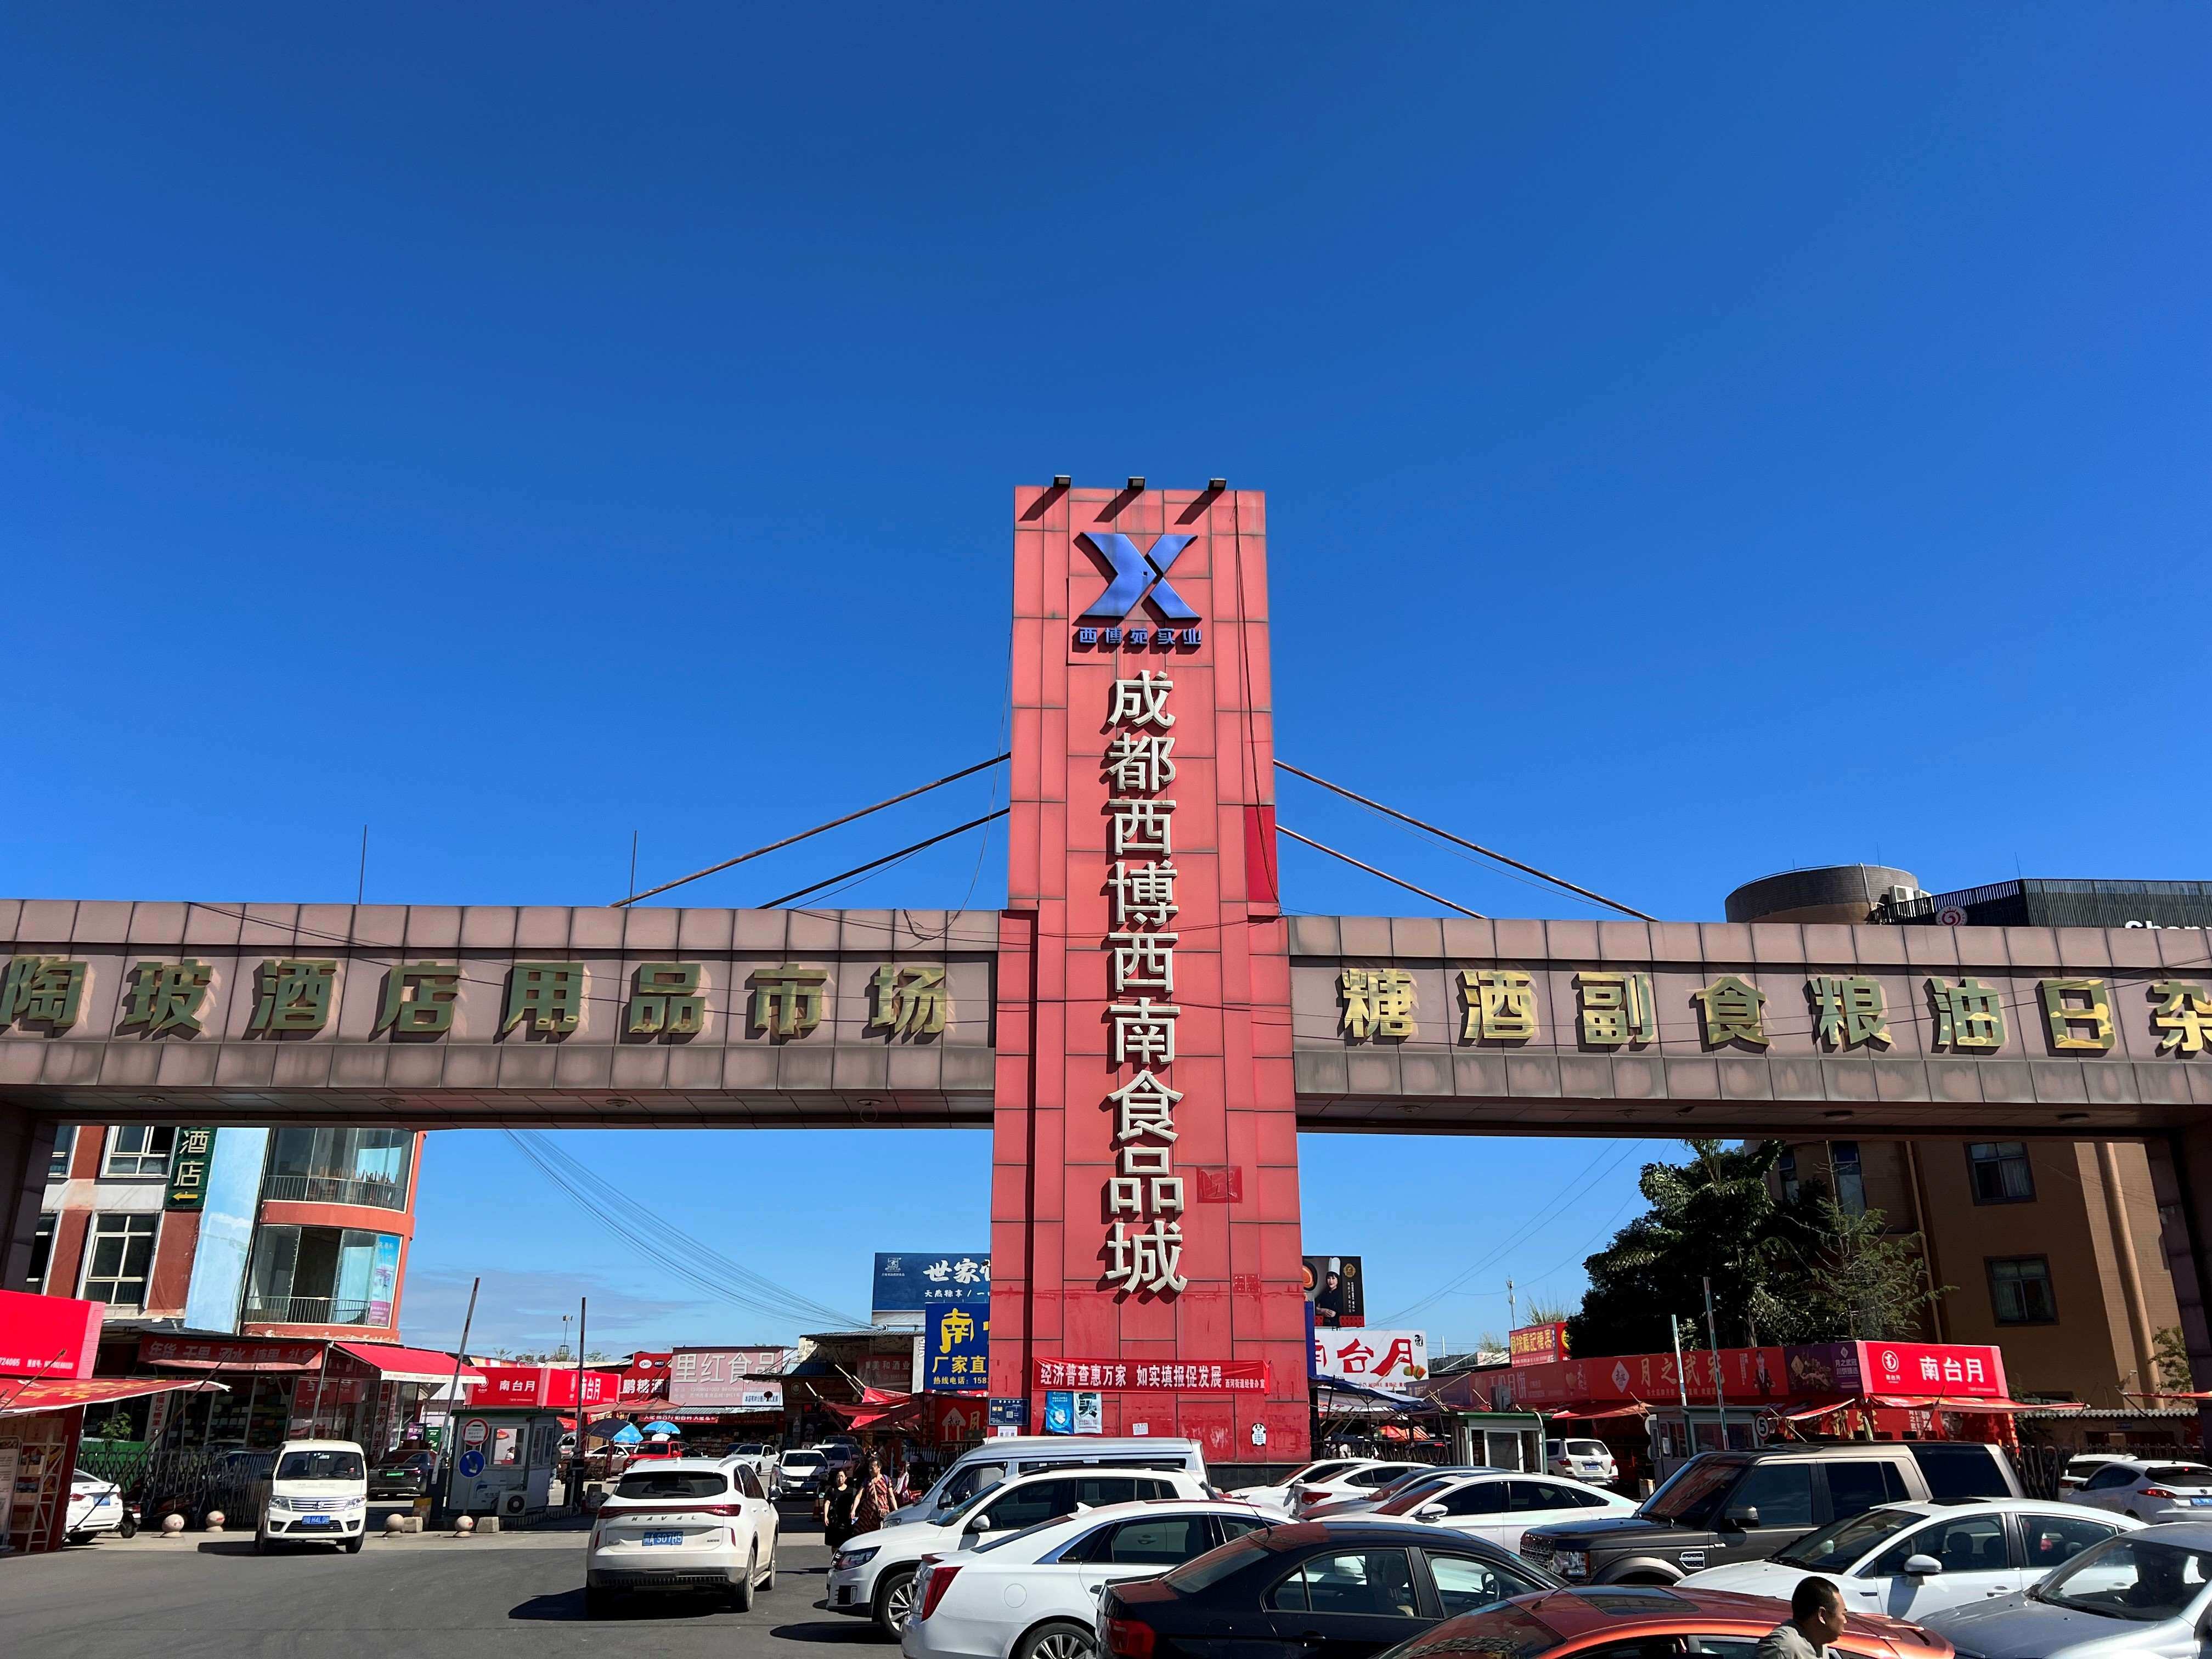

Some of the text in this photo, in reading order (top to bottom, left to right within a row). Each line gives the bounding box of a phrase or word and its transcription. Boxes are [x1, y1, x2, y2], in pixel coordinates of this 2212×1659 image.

[1080, 627, 1202, 645] 西博苑实业
[0, 956, 946, 1034] 陶玻酒店用品市场
[1105, 669, 1187, 1294] 成都西博西南食品城
[1342, 968, 2212, 1052] 糖酒副食粮油日杂
[173, 1130, 211, 1187] 酒店
[939, 1308, 989, 1353] 南
[673, 1352, 778, 1384] 里红食品
[932, 1355, 986, 1374] 厂家直
[1040, 1365, 1126, 1386] 经济普查惠万家
[1136, 1365, 1222, 1388] 如实填报促发展
[1919, 1356, 1984, 1383] 南台月
[499, 1380, 535, 1392] 南台月
[623, 1378, 671, 1393] 鹏糖酒
[1759, 1419, 1767, 1434] 5
